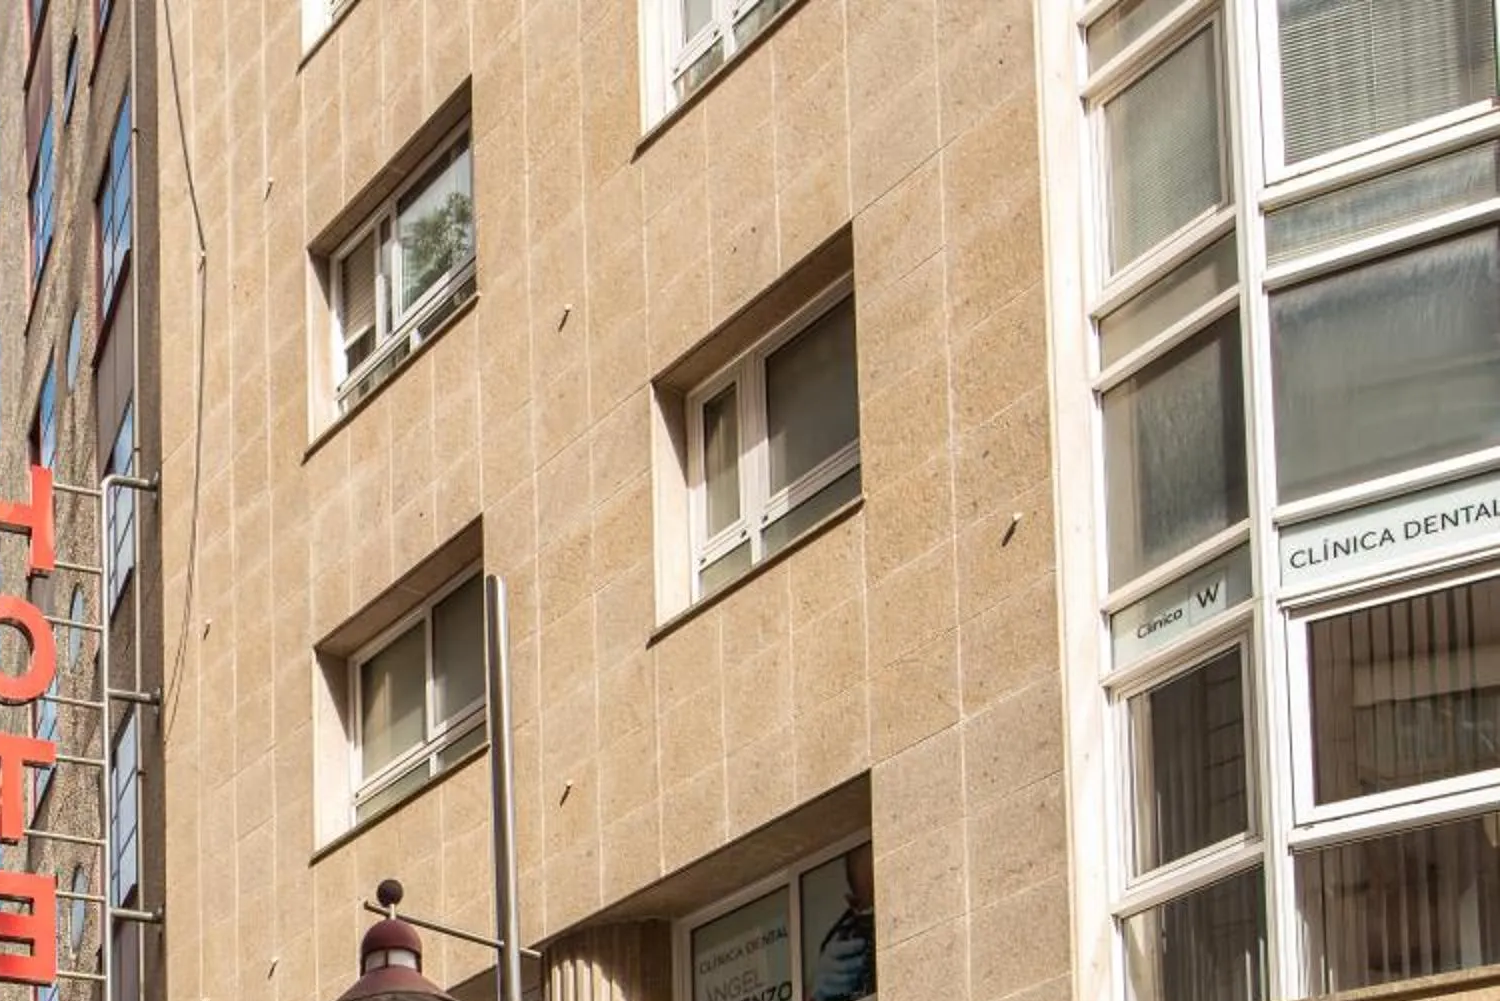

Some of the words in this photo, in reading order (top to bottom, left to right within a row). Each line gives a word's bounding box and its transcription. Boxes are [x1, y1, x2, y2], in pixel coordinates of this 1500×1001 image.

[1290, 528, 1395, 569] CLÍNICA
[1404, 499, 1500, 541] DENTAL
[1196, 582, 1220, 608] W
[745, 926, 789, 954] DENTAL
